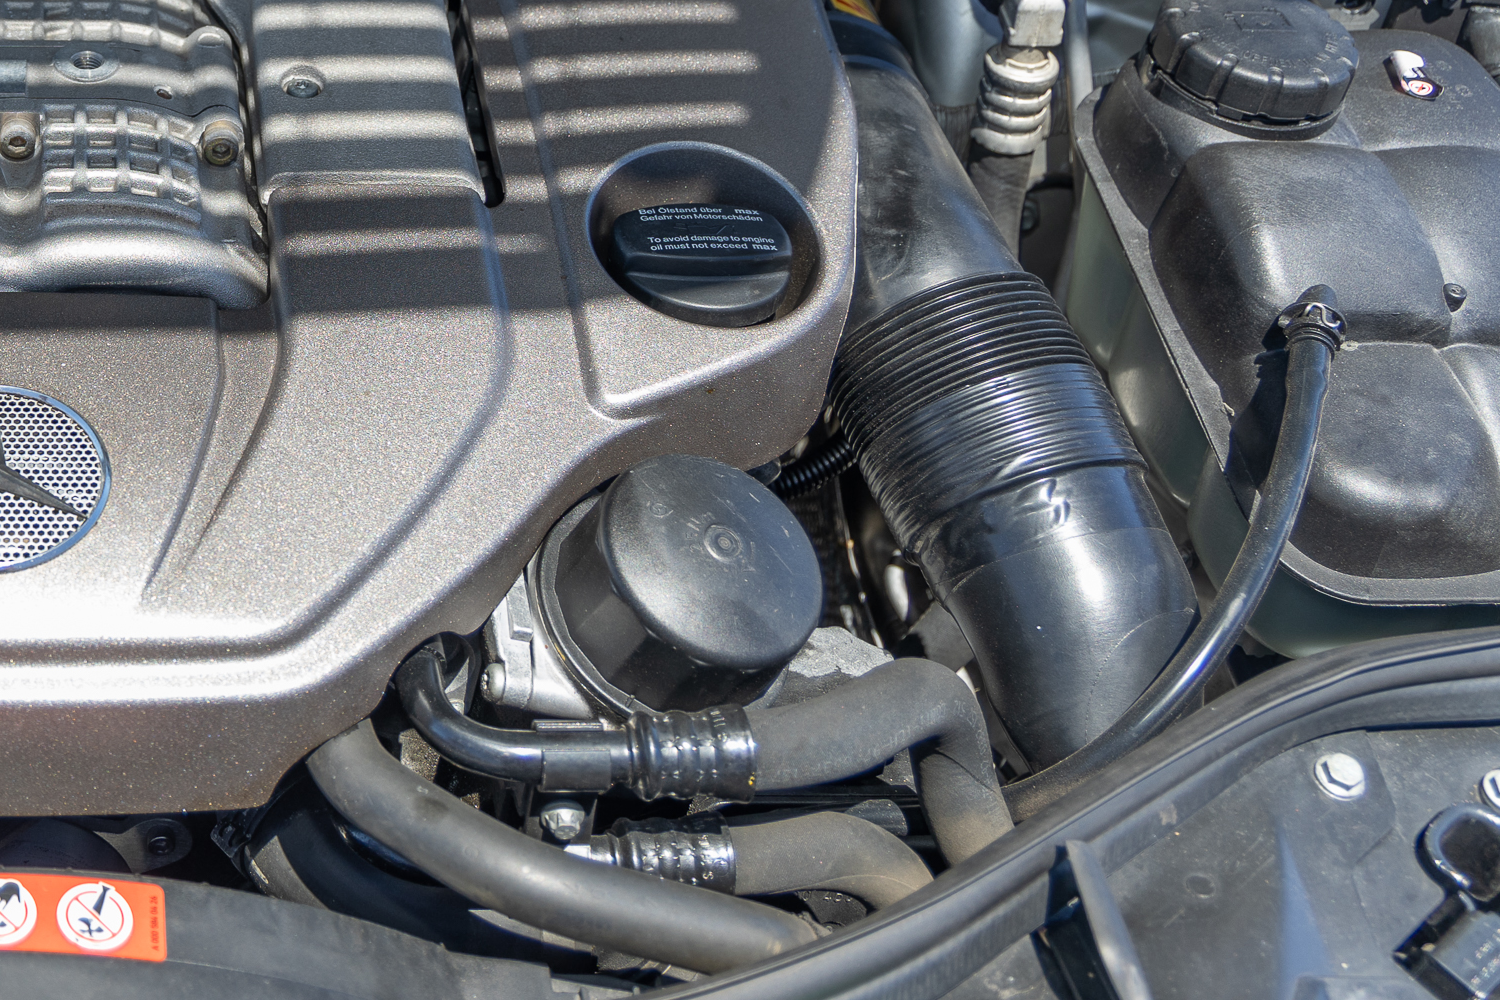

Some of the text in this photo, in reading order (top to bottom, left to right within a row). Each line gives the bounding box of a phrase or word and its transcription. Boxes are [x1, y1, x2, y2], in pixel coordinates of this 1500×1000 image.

[658, 206, 698, 214] Ölstand
[693, 213, 763, 222] Motorschäden
[662, 235, 690, 243] avoid
[690, 235, 729, 243] damage
[741, 236, 775, 244] engine
[664, 242, 691, 250] must
[710, 242, 749, 250] exceed
[752, 243, 778, 251] max
